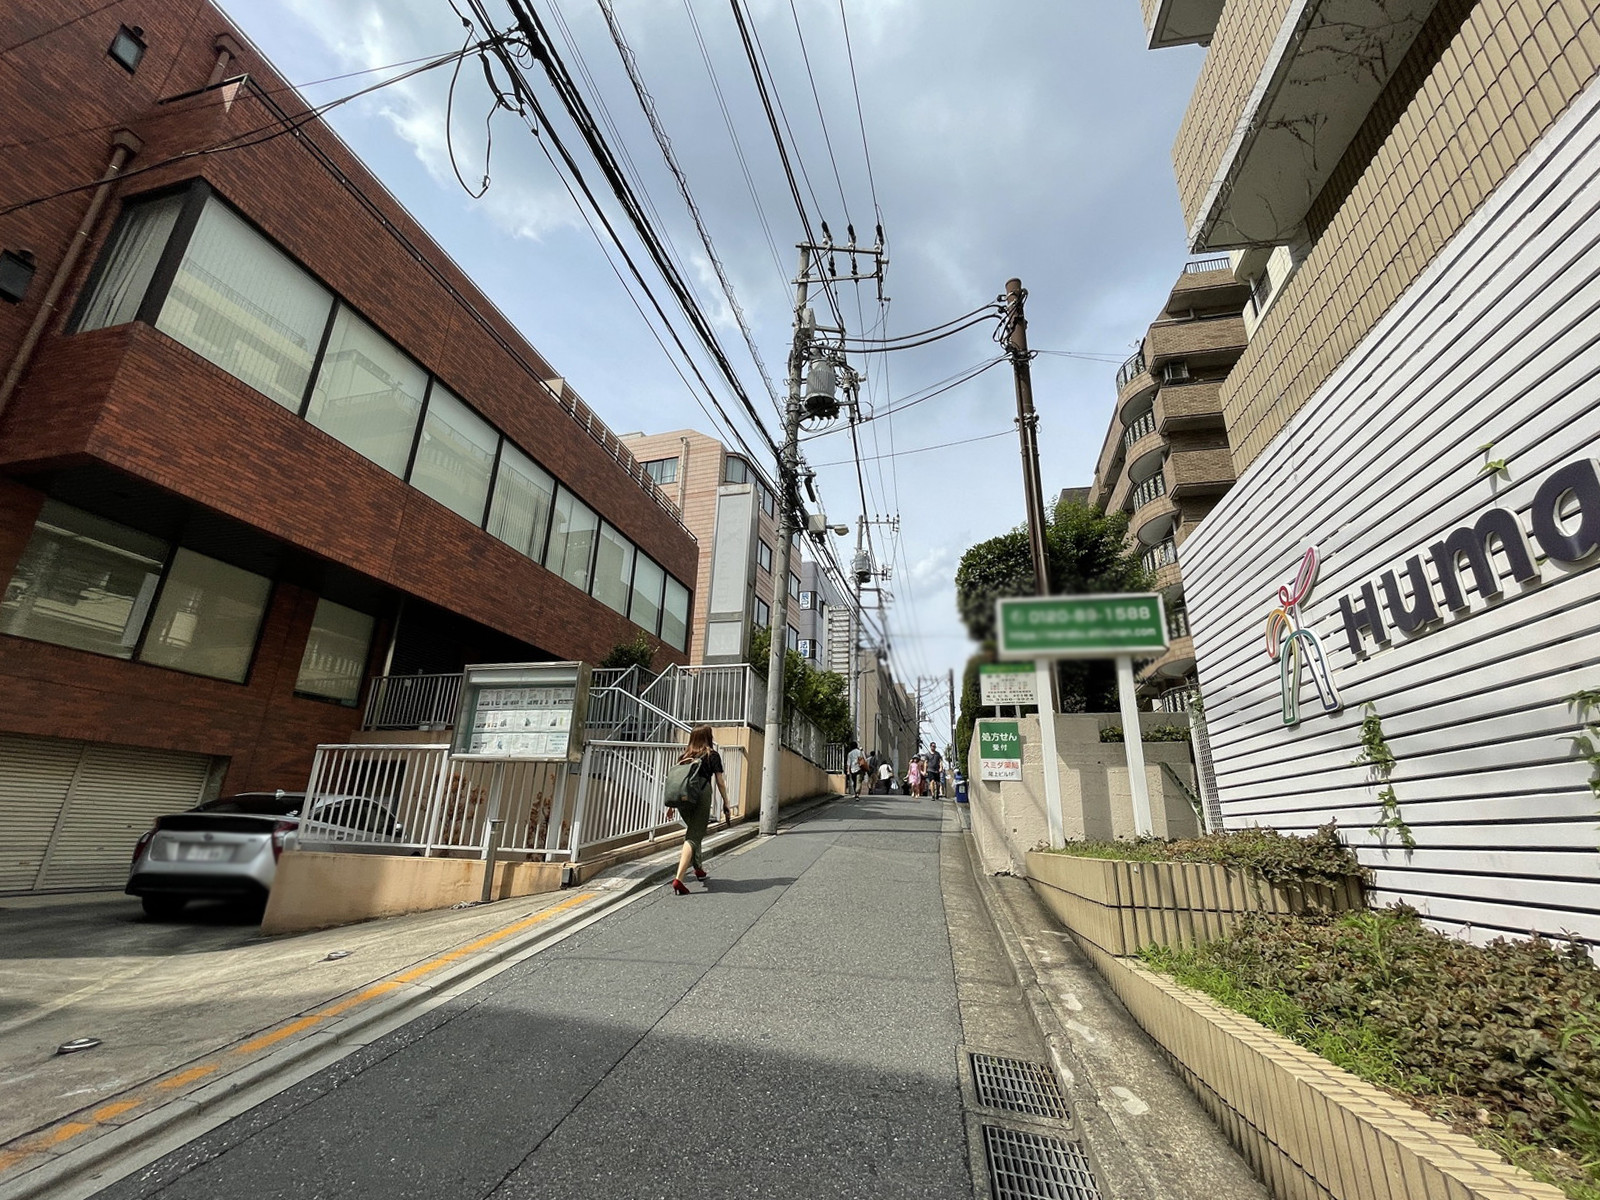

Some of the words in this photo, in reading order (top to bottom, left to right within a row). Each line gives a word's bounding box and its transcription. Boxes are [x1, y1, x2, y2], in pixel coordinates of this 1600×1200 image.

[981, 732, 1018, 742] 処方せん
[992, 743, 1008, 752] 受付
